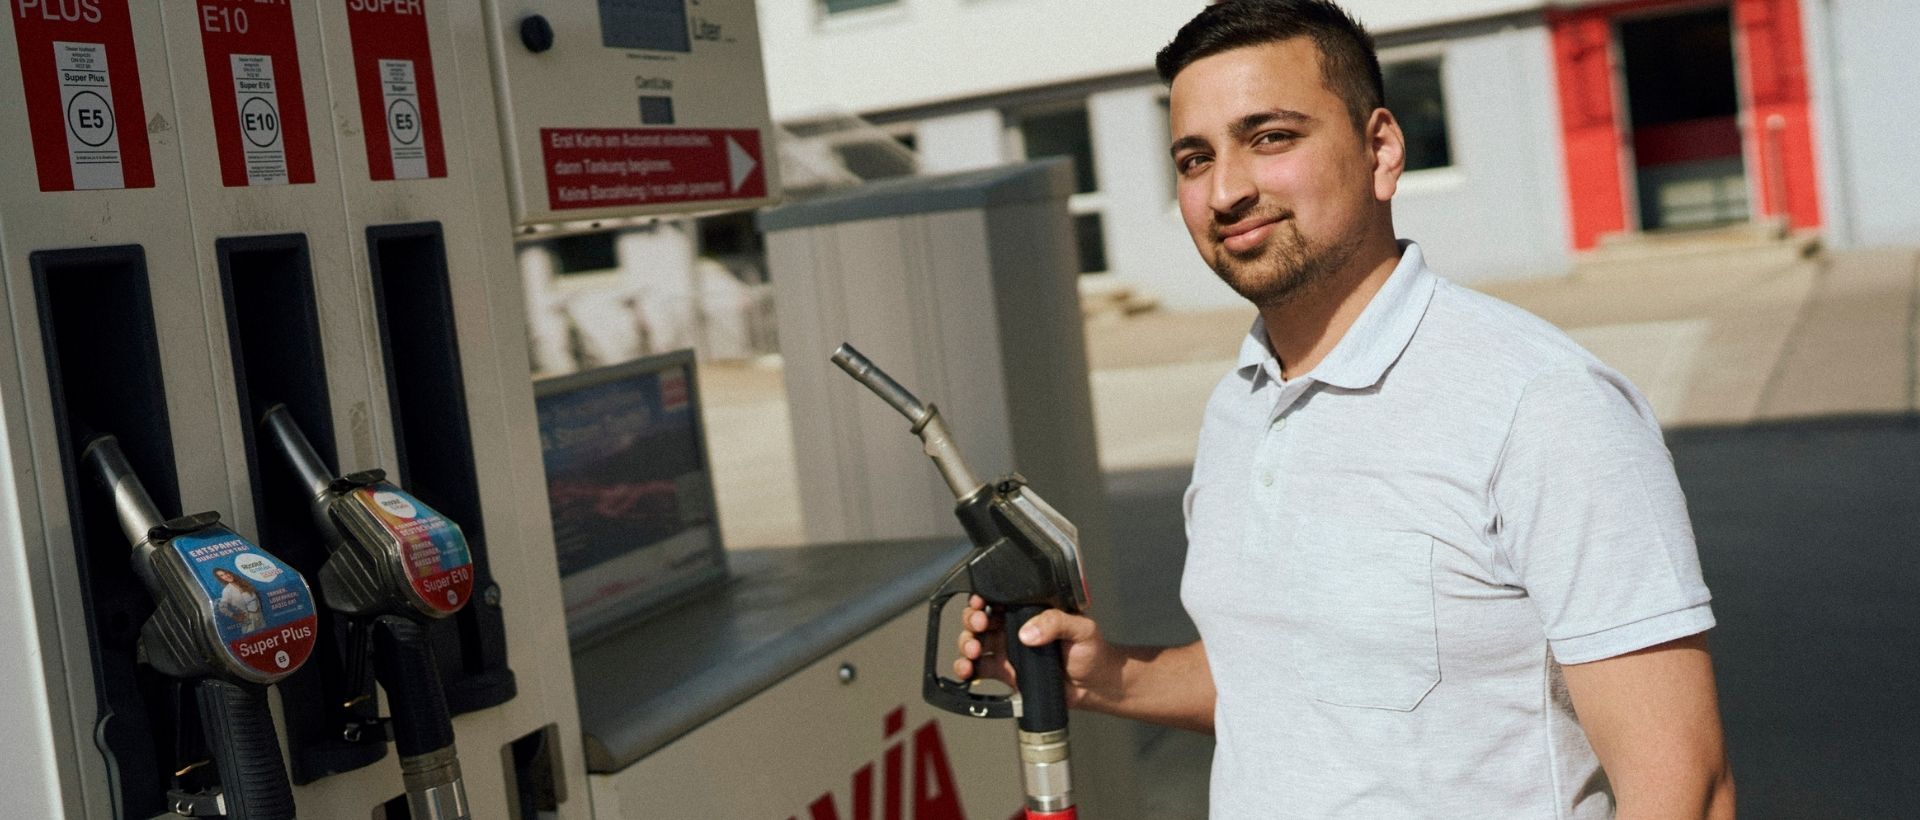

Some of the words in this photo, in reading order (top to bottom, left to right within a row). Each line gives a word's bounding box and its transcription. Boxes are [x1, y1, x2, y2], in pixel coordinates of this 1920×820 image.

[17, 0, 102, 24] PLUS
[202, 5, 248, 34] E10
[64, 73, 87, 83] Super
[88, 73, 105, 82] Plus
[239, 81, 257, 90] Super
[258, 81, 270, 89] E10
[78, 108, 104, 130] E5
[245, 112, 275, 132] E10
[395, 113, 414, 131] E5
[188, 539, 243, 557] ENTSPANNT
[423, 576, 451, 593] Super
[451, 568, 469, 584] E10
[240, 635, 280, 657] Super
[281, 626, 312, 643] Plus
